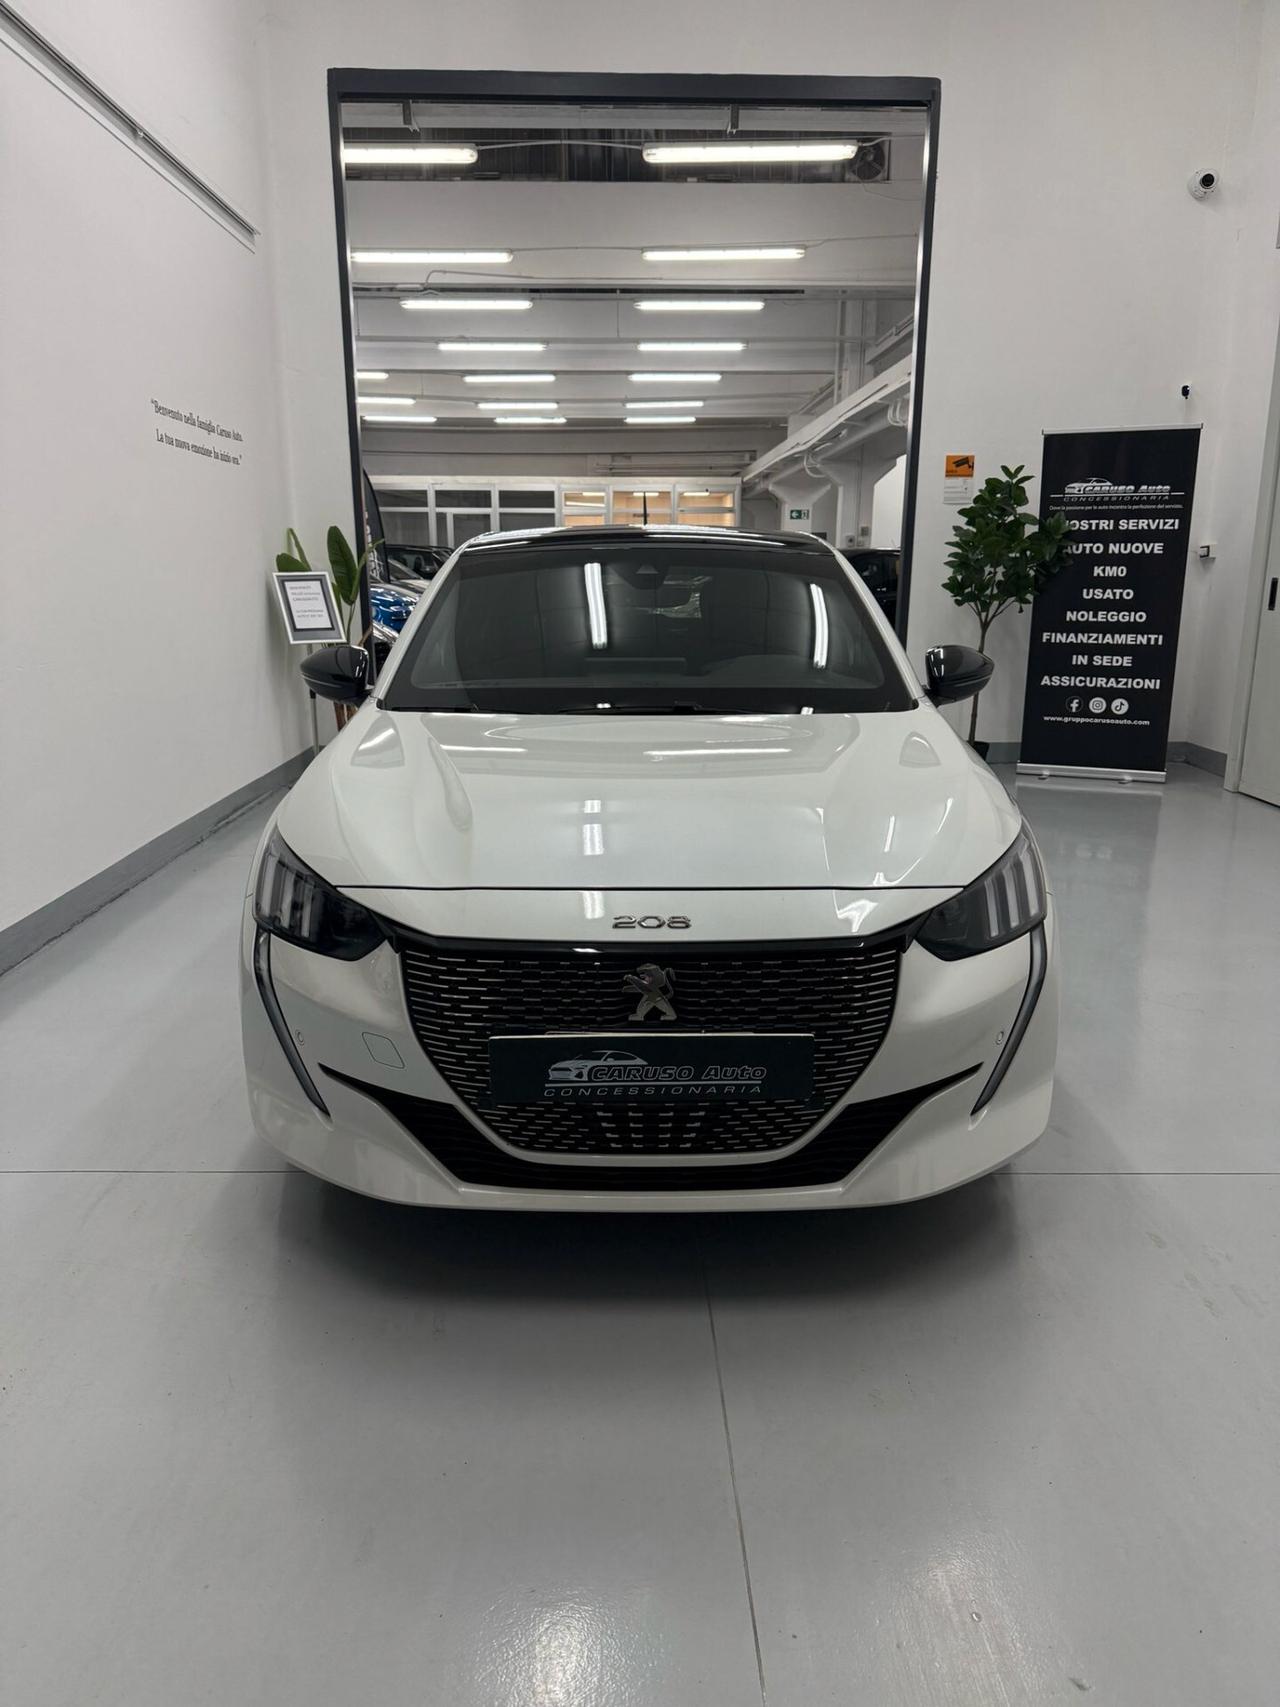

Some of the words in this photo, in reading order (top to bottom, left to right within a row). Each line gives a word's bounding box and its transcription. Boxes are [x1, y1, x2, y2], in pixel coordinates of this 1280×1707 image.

[1085, 486, 1135, 494] CARUSO
[1138, 485, 1171, 493] Auto
[1066, 519, 1114, 531] OSTRI
[1118, 518, 1180, 530] SERVIZI
[1108, 543, 1164, 554] NUOVE
[1082, 589, 1134, 600] USATO
[1066, 611, 1147, 622] NOLEGGIO
[1042, 632, 1164, 646] FINANZIAMENTI
[1072, 655, 1088, 665] IN
[1093, 656, 1133, 667] SEDE
[1040, 675, 1161, 690] ASSICURAZIONI
[1043, 716, 1150, 726] www.gruppocarusoauto.com
[612, 915, 691, 930] 208
[591, 1065, 695, 1082] CARUSO
[700, 1065, 768, 1081] Auto
[543, 1085, 762, 1098] CONCESSIONARIA
